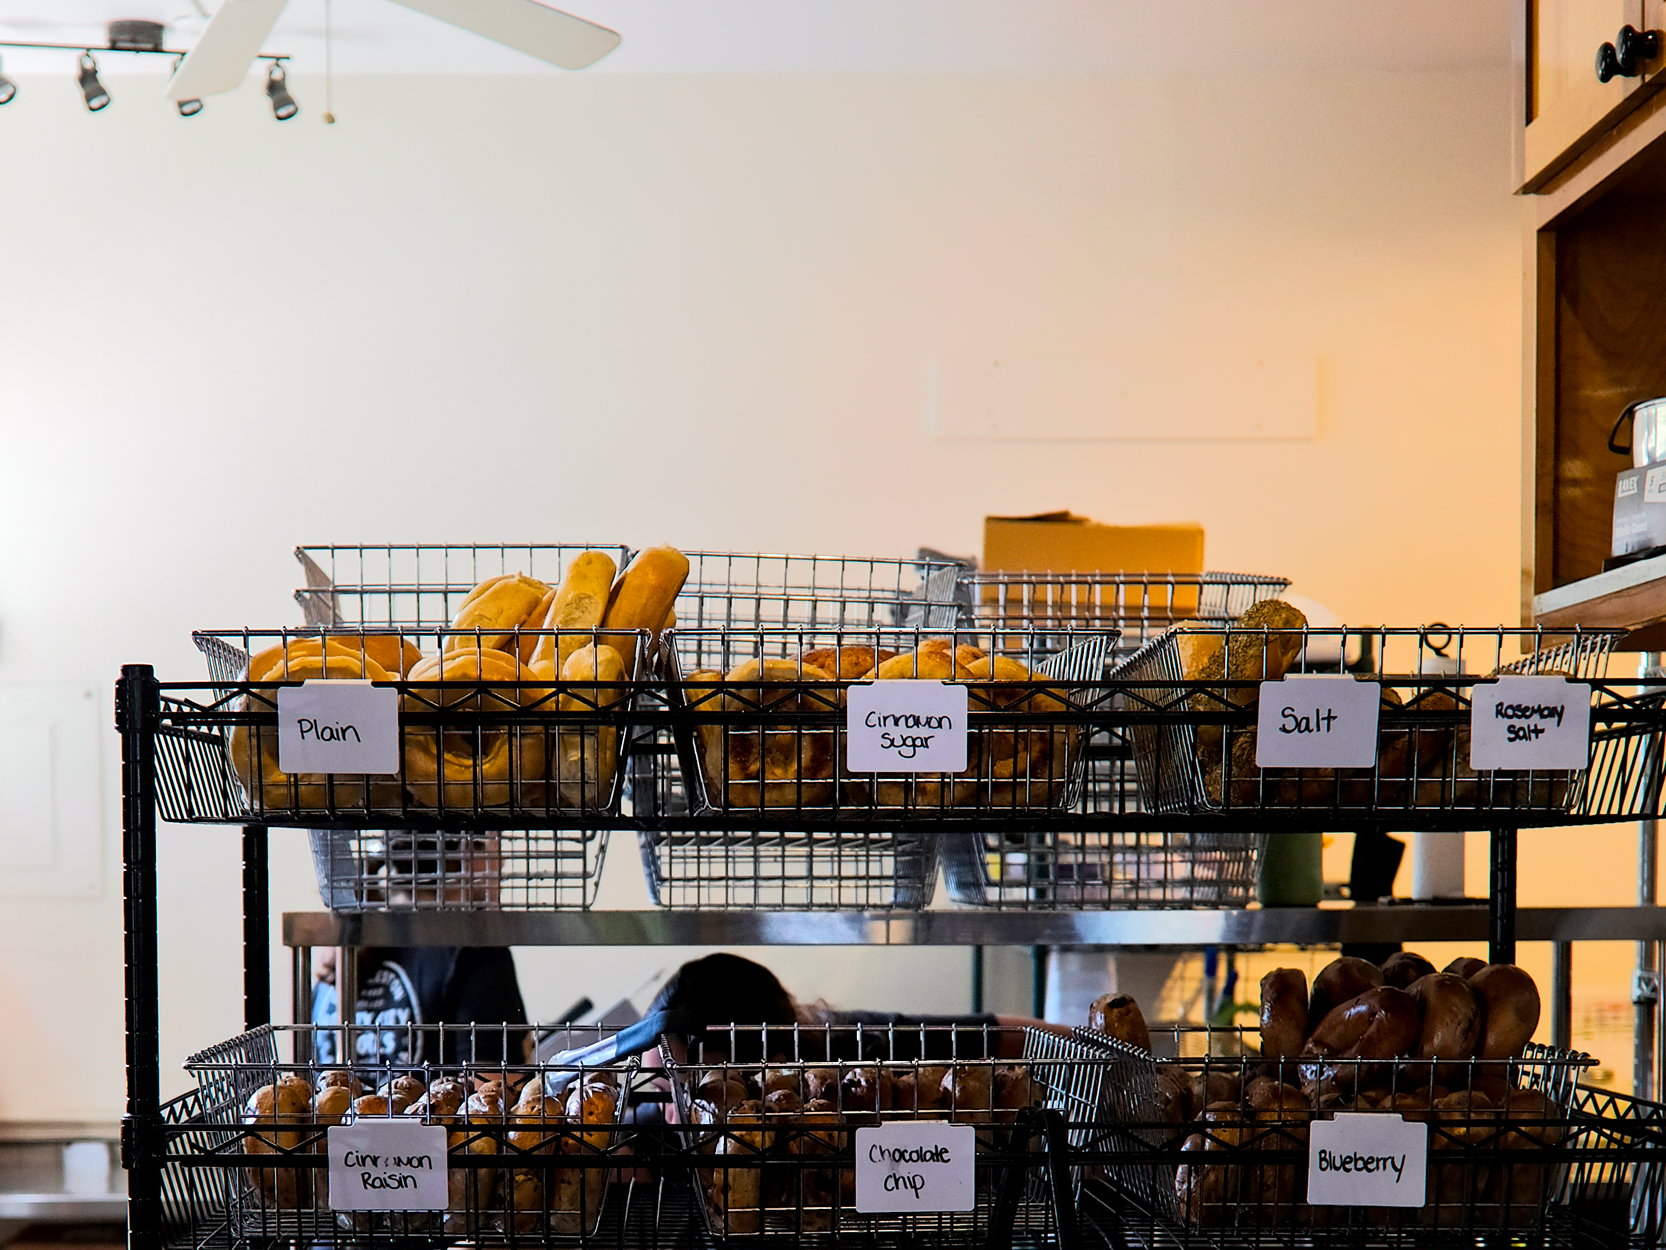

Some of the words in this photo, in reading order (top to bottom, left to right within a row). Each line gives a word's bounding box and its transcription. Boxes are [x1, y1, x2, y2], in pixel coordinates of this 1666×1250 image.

[864, 710, 952, 730] Cinnamon
[1279, 706, 1338, 734] Salt
[1494, 702, 1566, 728] Rosemary
[297, 718, 361, 742] Plain
[1506, 724, 1546, 743] Salt
[868, 1143, 952, 1164] Chocolate
[1318, 1148, 1406, 1184] Blueberry
[360, 1171, 418, 1190] Raisin
